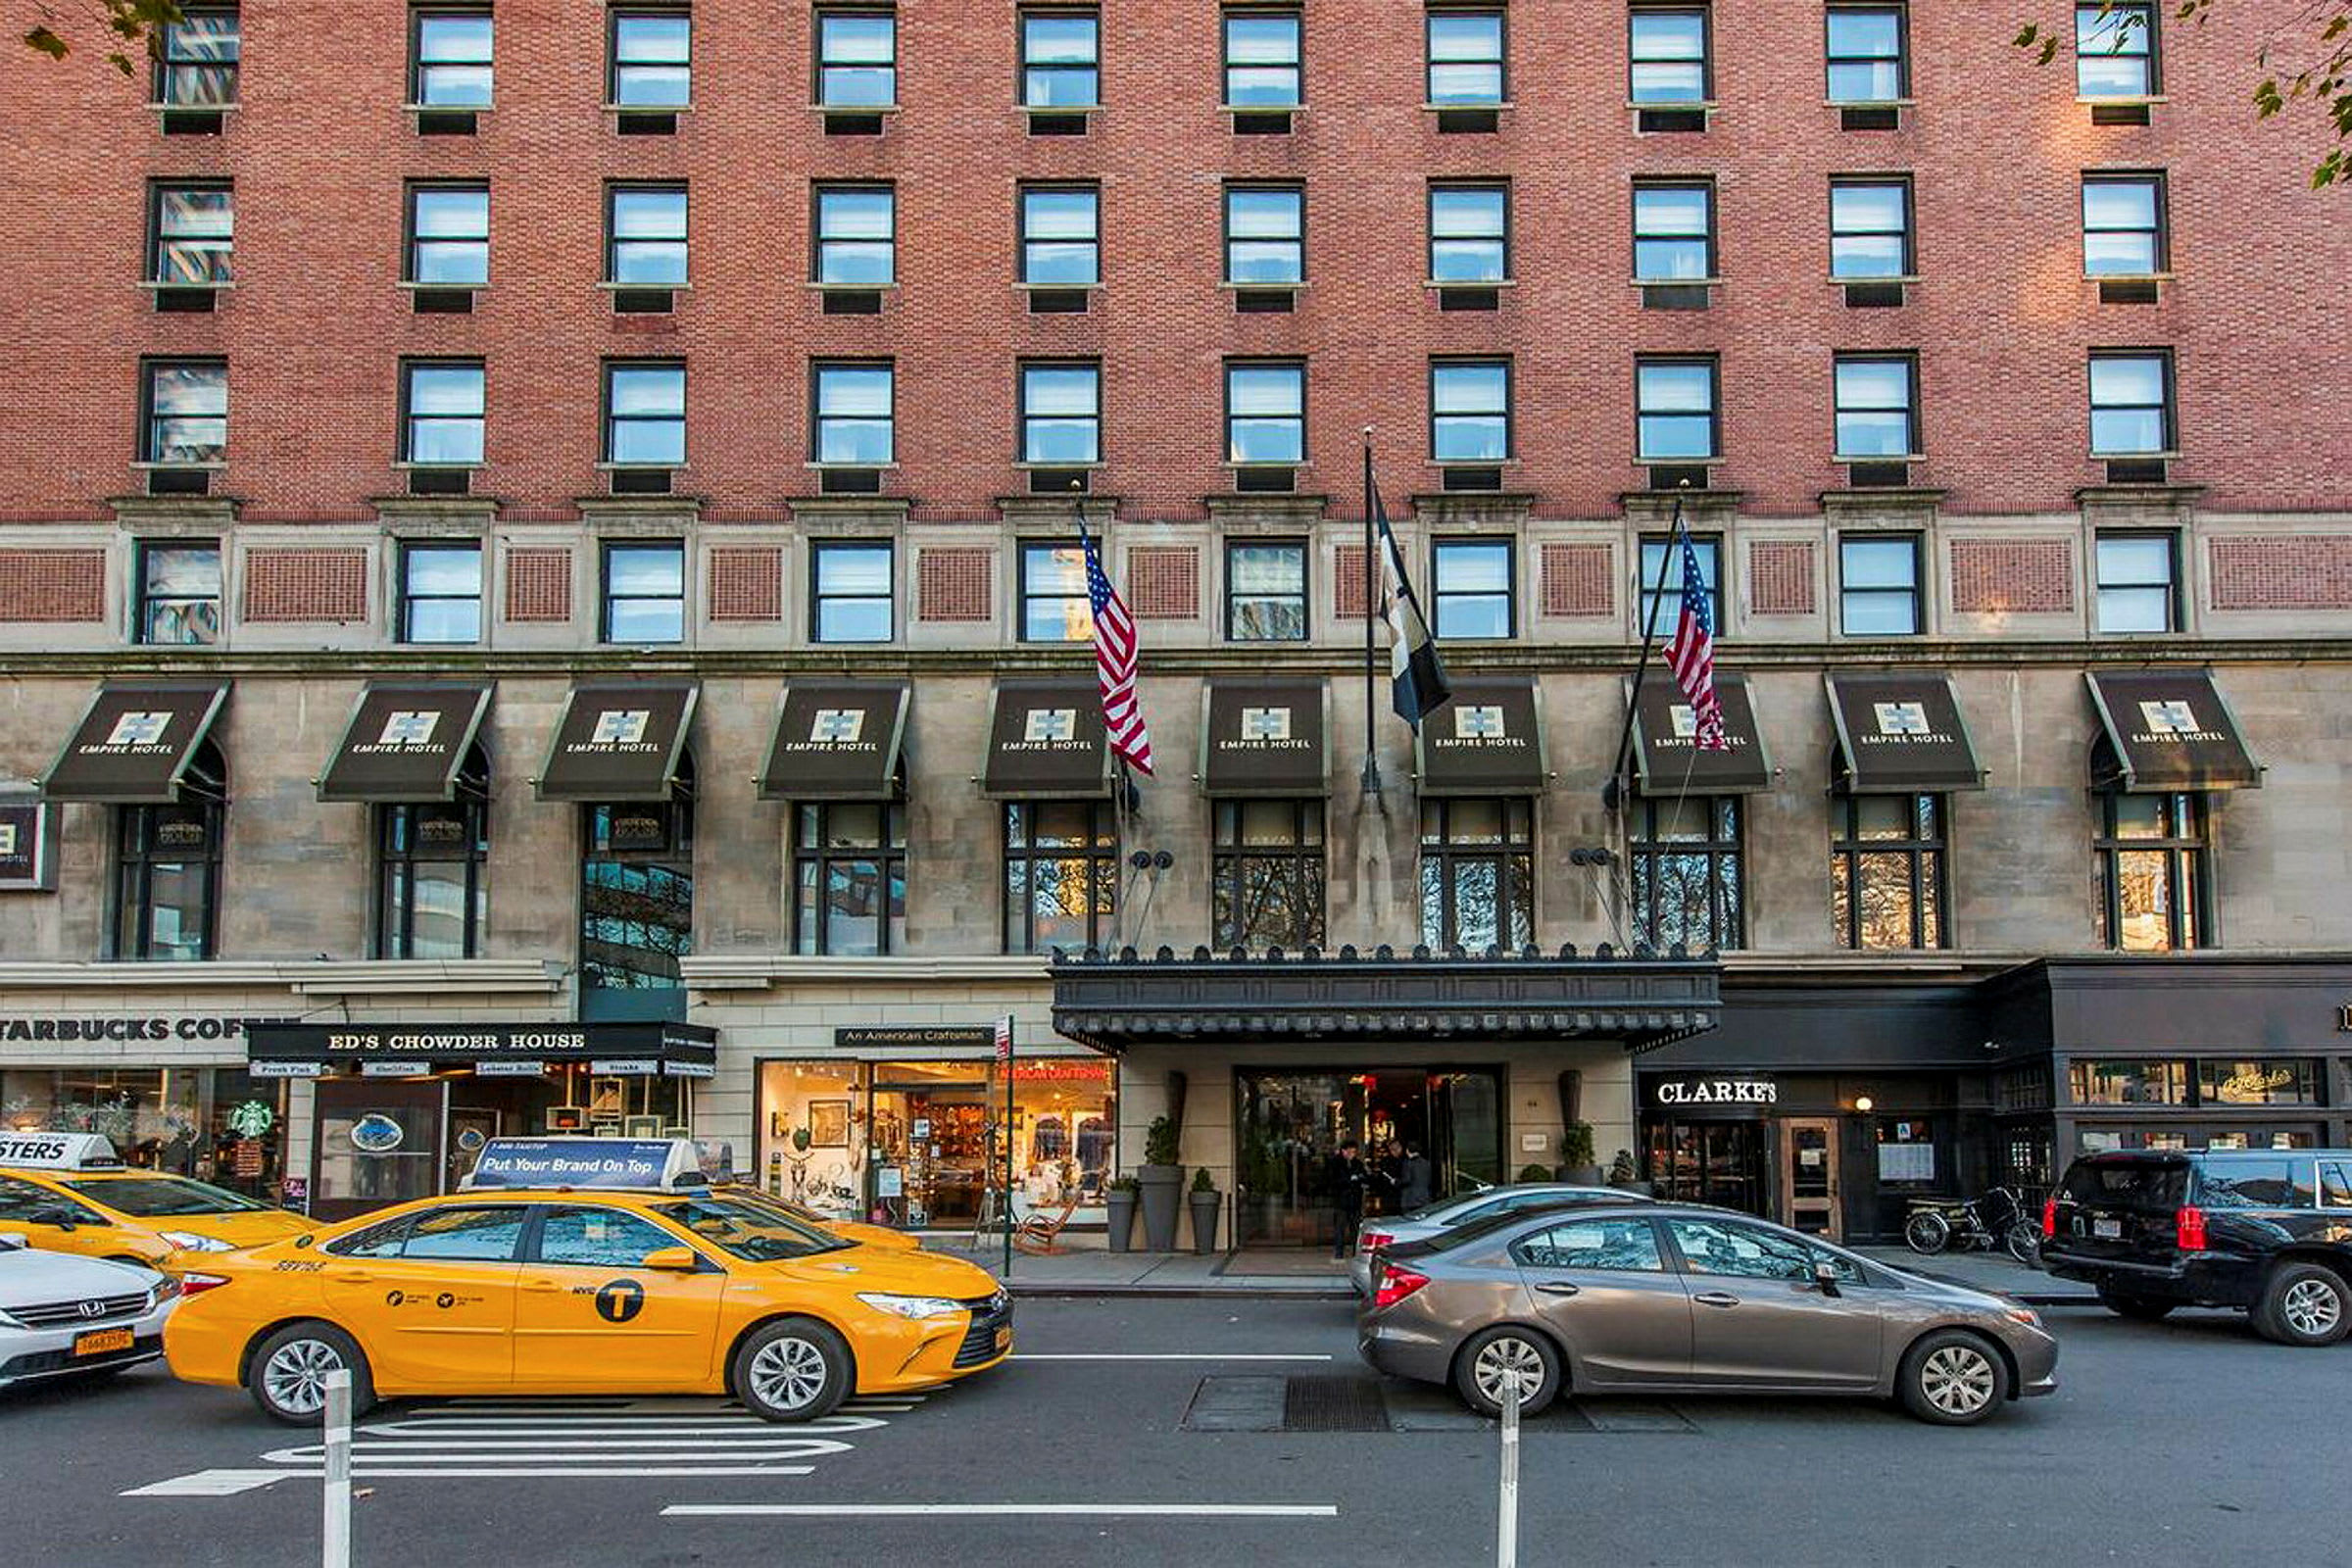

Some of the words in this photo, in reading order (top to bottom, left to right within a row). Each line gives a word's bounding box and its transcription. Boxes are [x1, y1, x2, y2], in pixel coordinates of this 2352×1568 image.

[1487, 738, 1526, 747] HOTEL
[1655, 738, 1695, 747] EMPIR
[1862, 735, 1908, 744] EMPIRE
[1911, 734, 1954, 743] HOTEL
[2132, 733, 2180, 743] EMPIRE
[2182, 732, 2226, 741] HOTEL
[566, 743, 615, 753] EMPIRE
[618, 743, 659, 752] HOTEL
[786, 742, 833, 751] EMPIRE
[837, 742, 877, 751] HOTEL
[1002, 742, 1048, 751] EMPIRE
[1053, 741, 1092, 750] HOTEL
[1270, 740, 1311, 749] HOTEL
[78, 745, 128, 755] EMPIRE
[131, 745, 173, 754] HOTEL
[0, 1018, 170, 1041] TARBUCKS
[845, 1031, 862, 1040] An
[864, 1031, 922, 1040] American
[924, 1030, 984, 1041] Craftsman
[328, 1035, 379, 1050] ED'S
[390, 1035, 499, 1050] CHOWDER
[510, 1033, 585, 1048] HOUSE
[0, 1141, 66, 1159] STERS
[483, 1157, 511, 1171] Put
[515, 1157, 550, 1172] Your
[552, 1157, 600, 1172] Brand
[603, 1159, 624, 1173] On
[627, 1159, 654, 1175] Top
[609, 1287, 636, 1318] T
